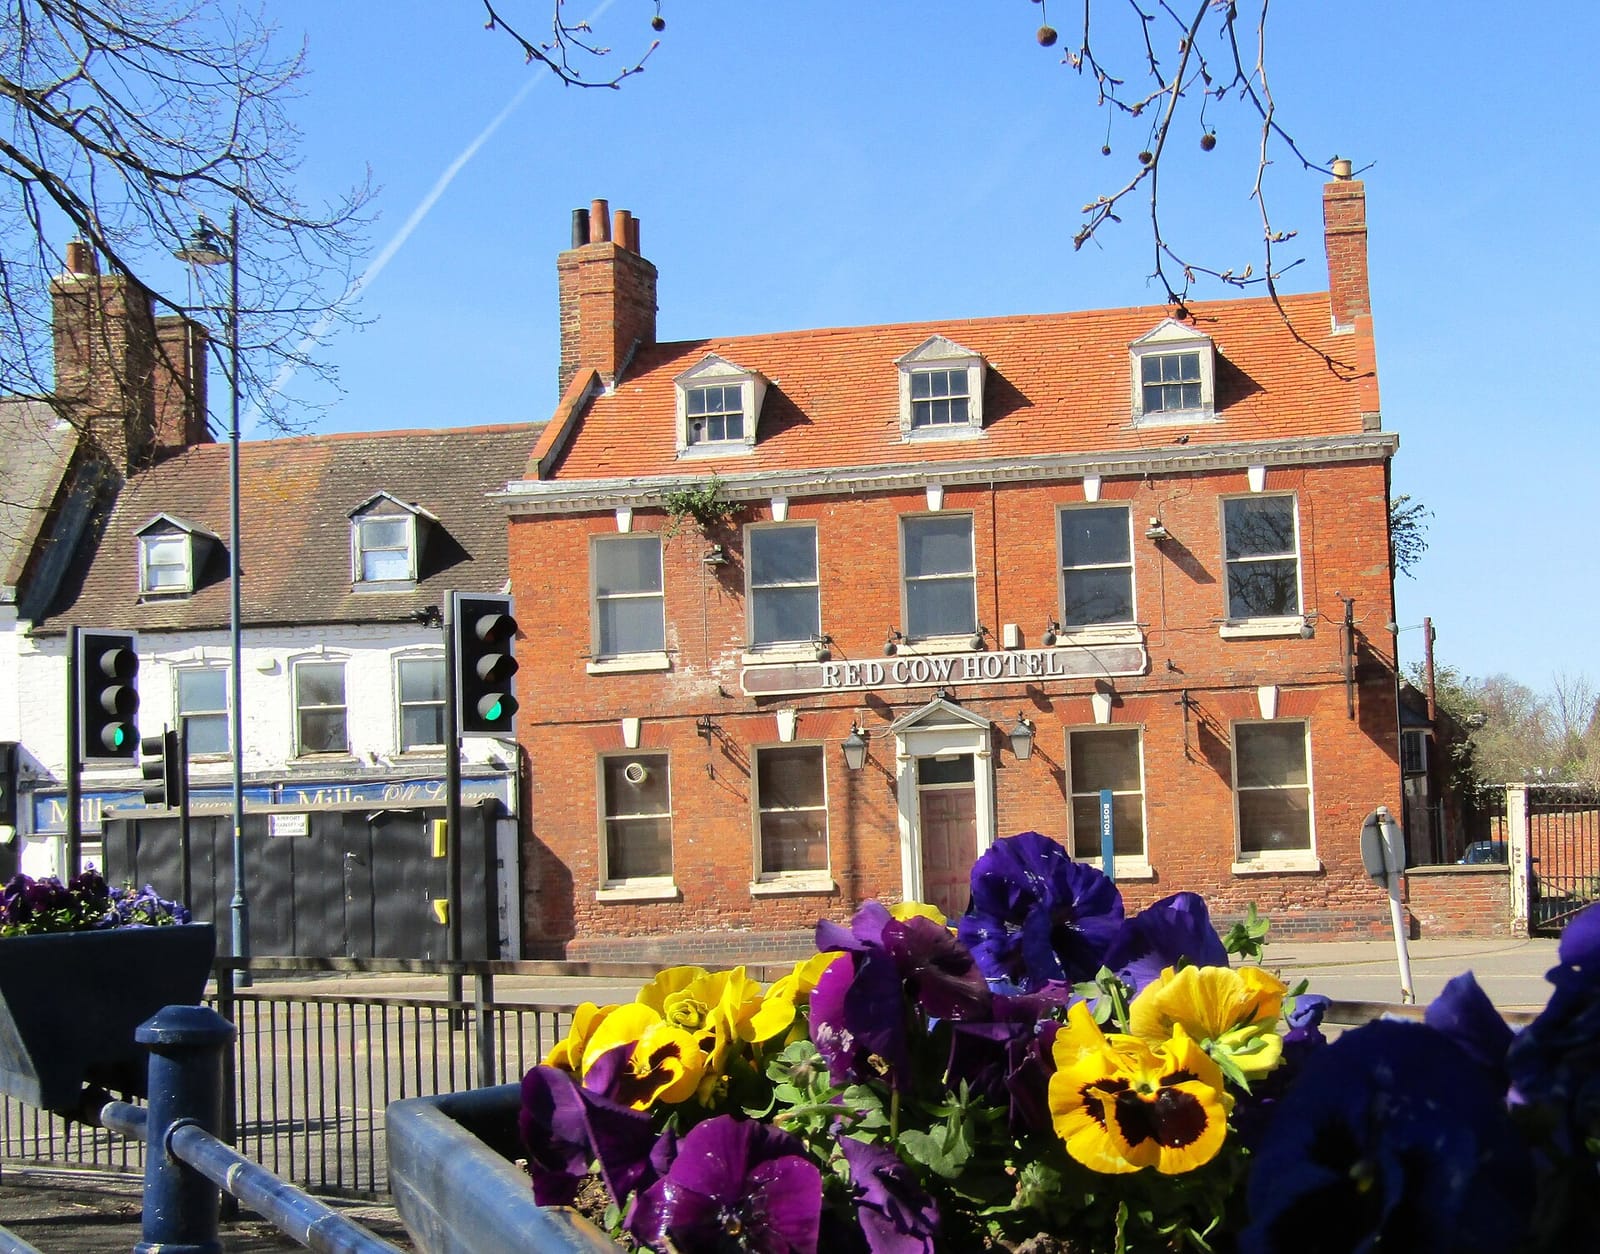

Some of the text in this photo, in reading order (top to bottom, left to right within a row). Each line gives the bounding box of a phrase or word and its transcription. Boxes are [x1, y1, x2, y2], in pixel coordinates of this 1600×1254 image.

[821, 652, 1064, 688] RED COW HOTEL
